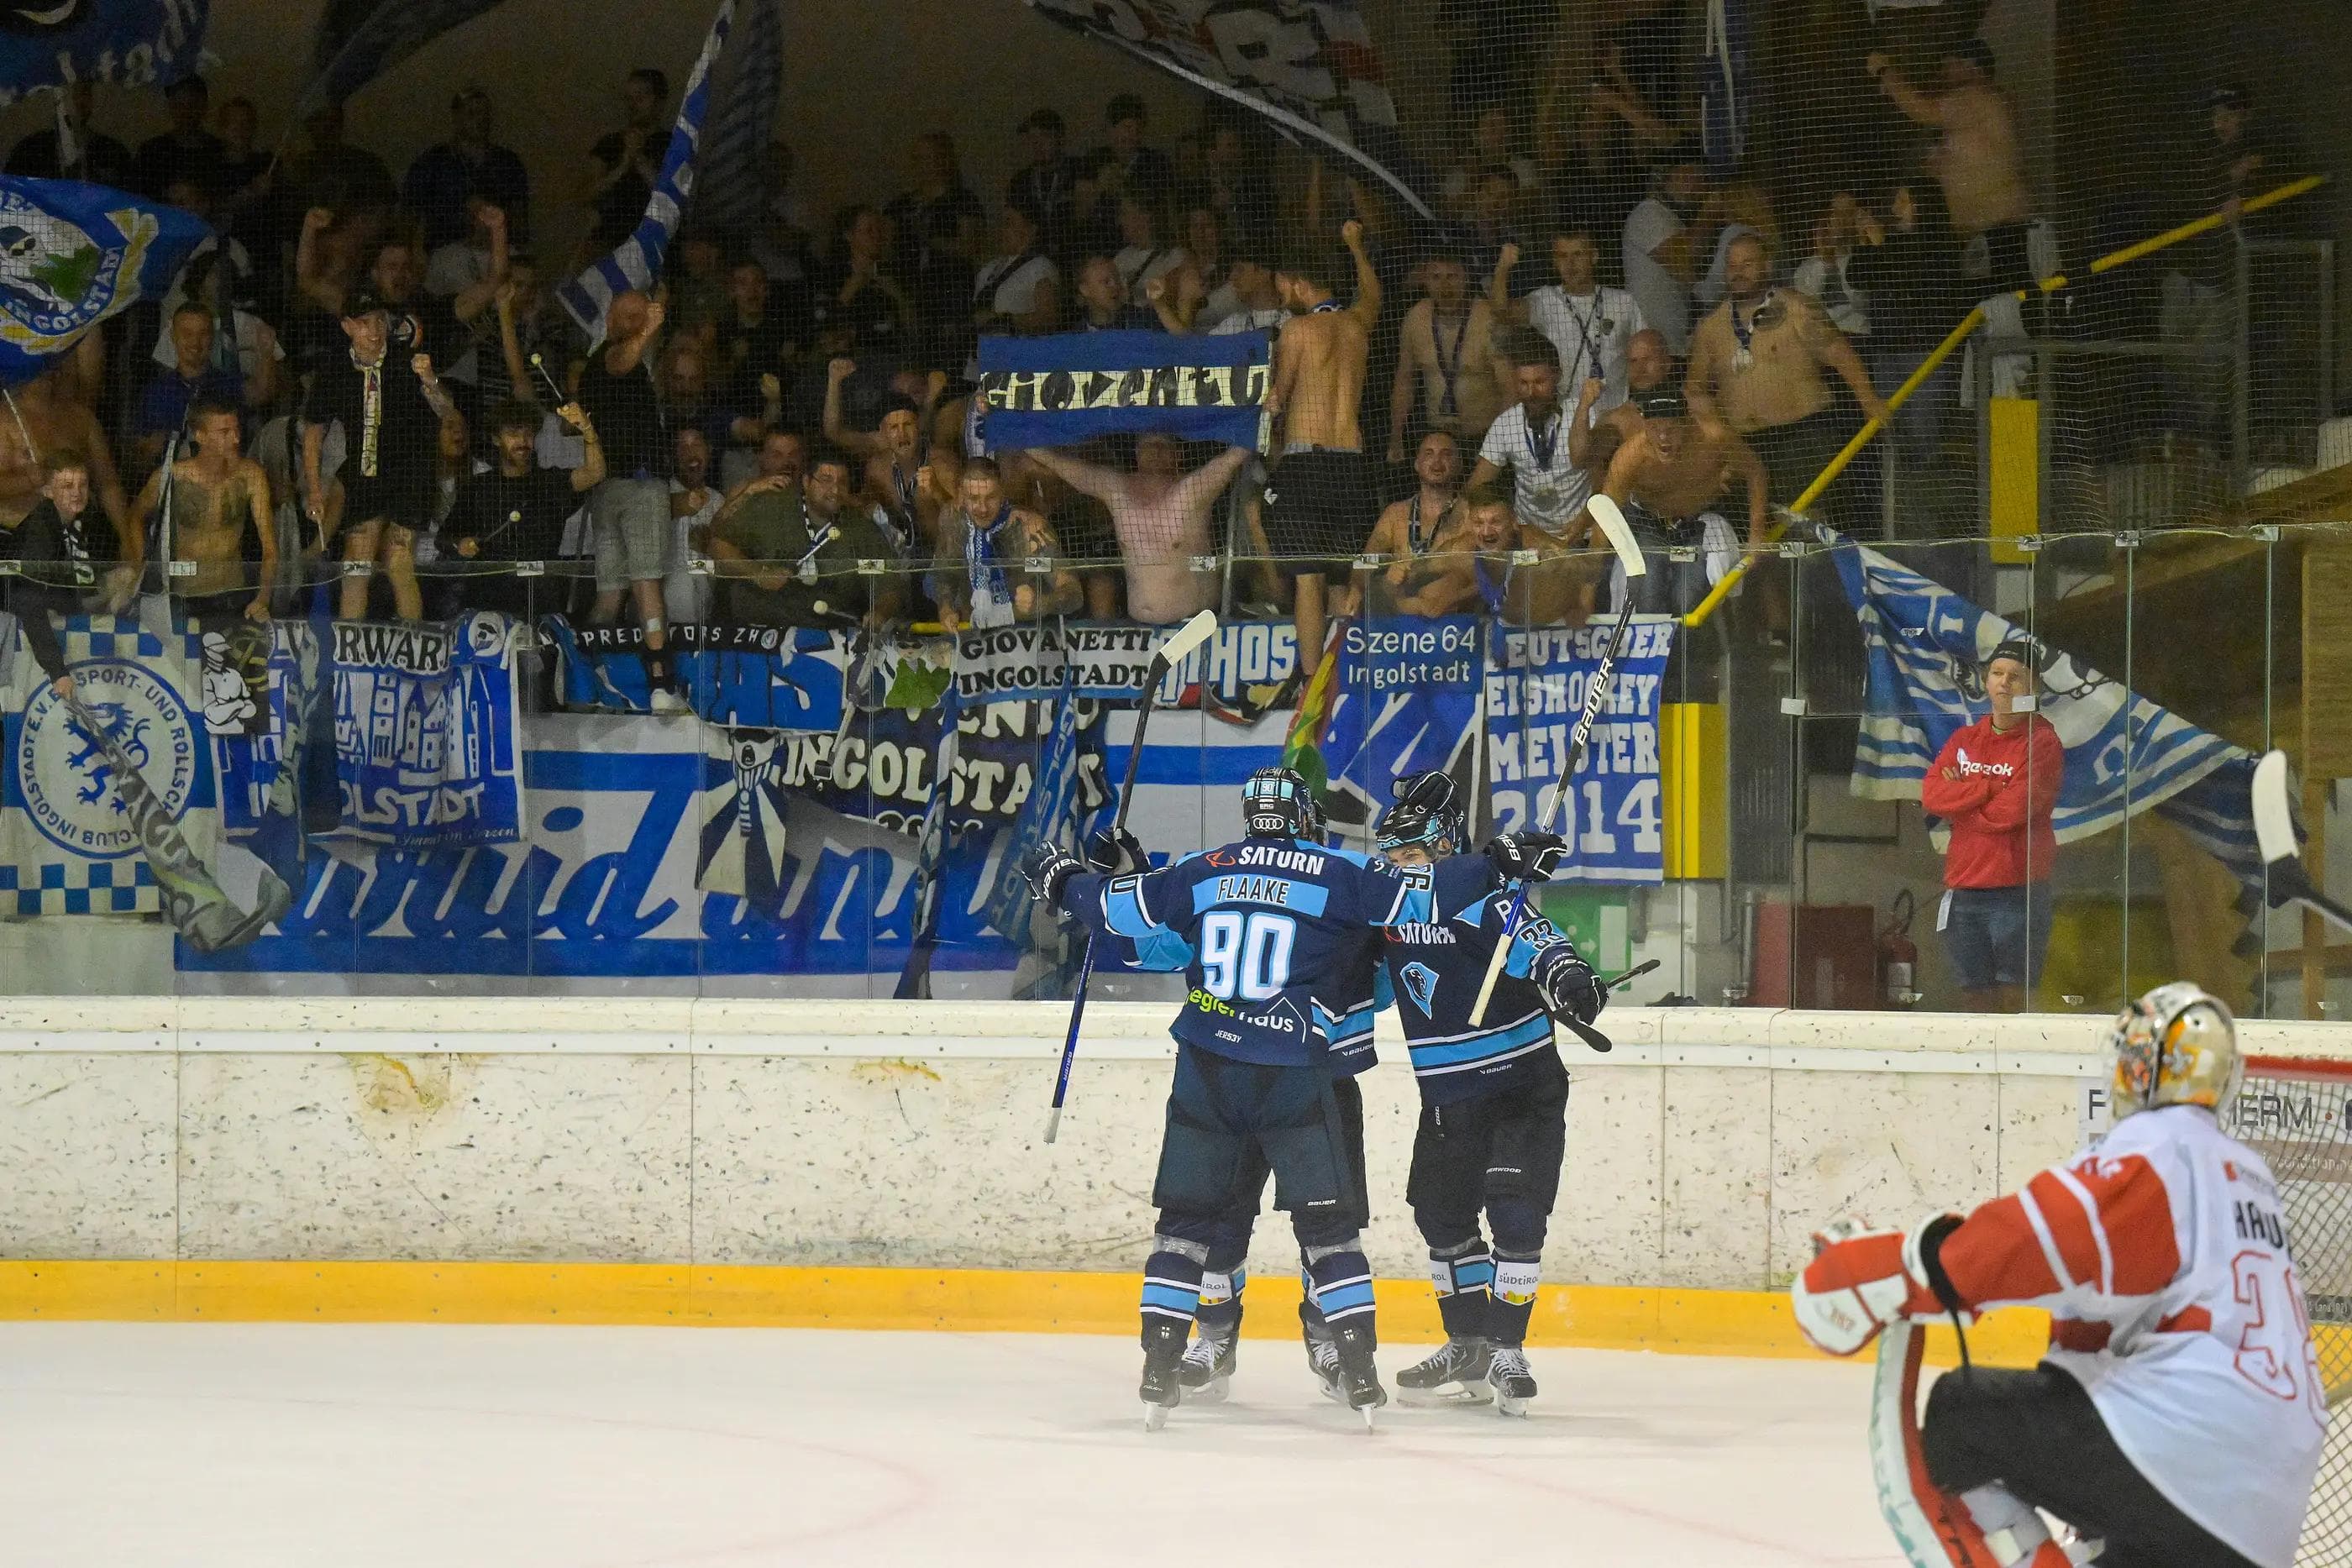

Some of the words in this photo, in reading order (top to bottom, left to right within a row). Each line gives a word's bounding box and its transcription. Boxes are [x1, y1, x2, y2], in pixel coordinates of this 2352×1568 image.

[960, 630, 1152, 660] GIOVANETTI
[1347, 627, 1436, 654] Szene
[1441, 625, 1476, 653] 64
[960, 663, 1148, 695] INGOLSTADT
[1348, 660, 1471, 690] Ingolstadt
[144, 684, 177, 723] UND
[1238, 846, 1325, 875] SATURN
[1216, 876, 1289, 905] FLAAKE
[1200, 910, 1297, 1002] 90
